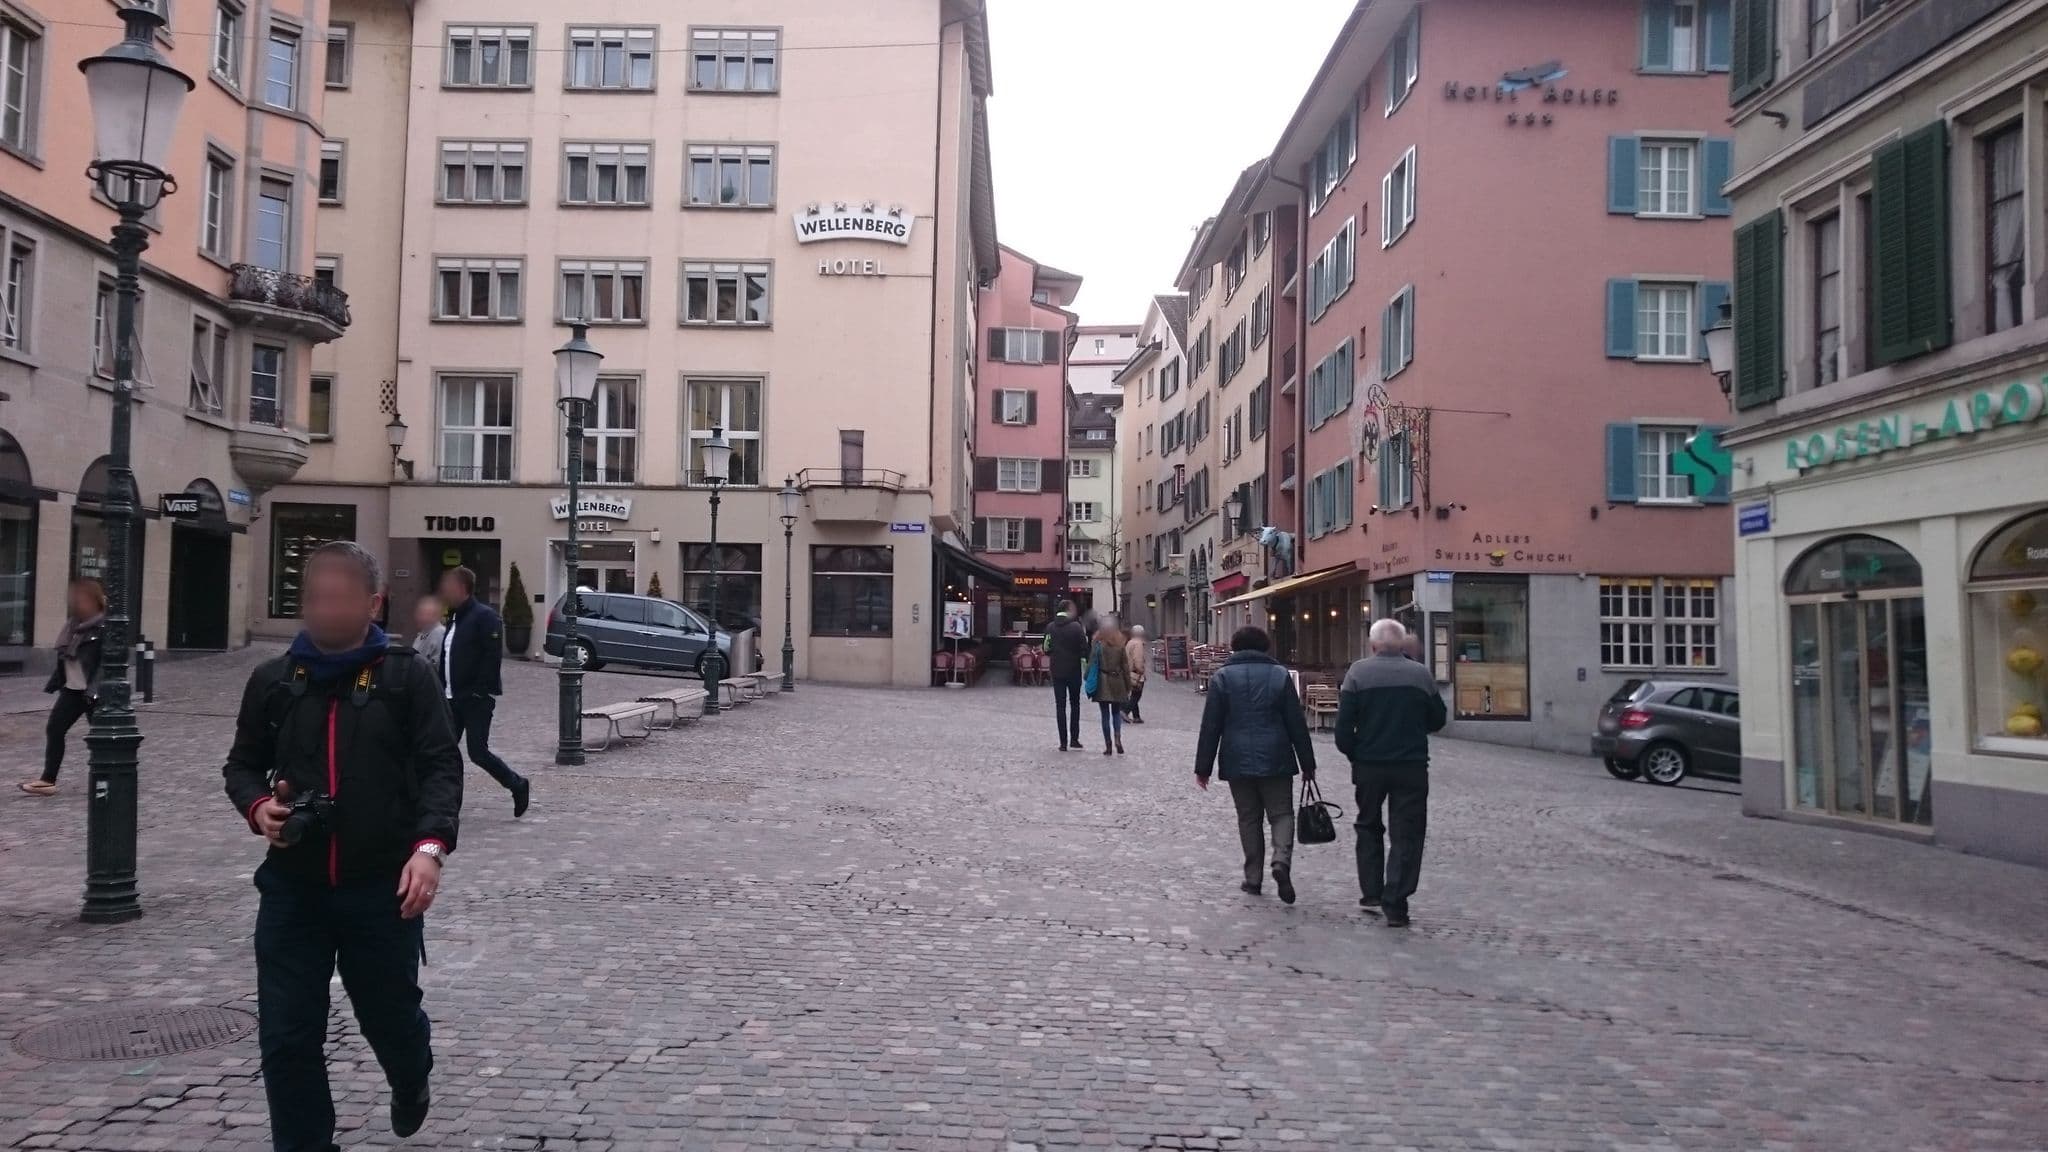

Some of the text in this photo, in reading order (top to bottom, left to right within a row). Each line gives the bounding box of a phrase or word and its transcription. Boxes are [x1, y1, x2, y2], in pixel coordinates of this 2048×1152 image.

[1444, 81, 1618, 104] HOTEL ADLER
[800, 217, 906, 237] WELLENBERG
[818, 258, 886, 275] HOTEL
[1786, 375, 2048, 470] ROSEN-APO
[165, 499, 198, 512] VANS
[554, 501, 626, 515] WLENBERG
[577, 520, 612, 532] OTEL
[1434, 549, 1572, 562] SWISS CHUCHI
